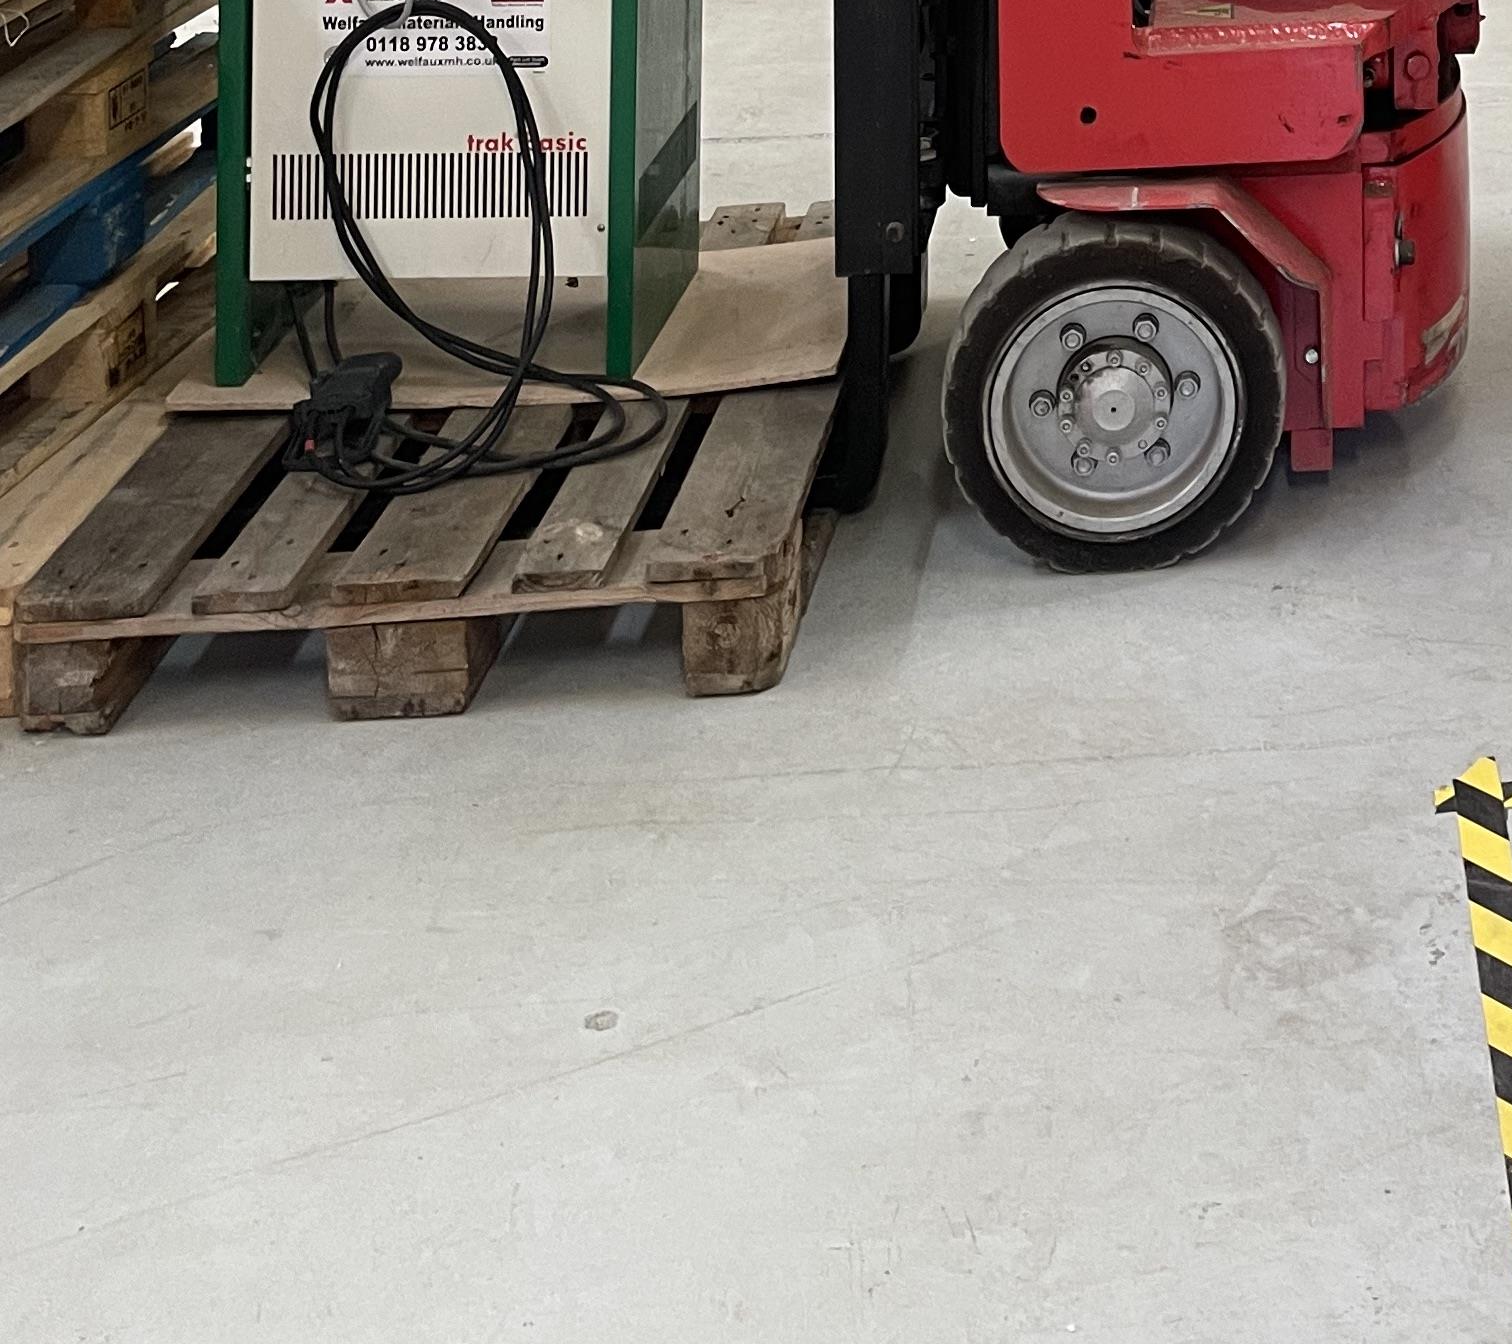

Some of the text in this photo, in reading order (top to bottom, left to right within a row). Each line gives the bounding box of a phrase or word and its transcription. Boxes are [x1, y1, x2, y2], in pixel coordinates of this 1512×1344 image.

[366, 36, 498, 52] 0118 978 38
[467, 131, 587, 151] trak asic
